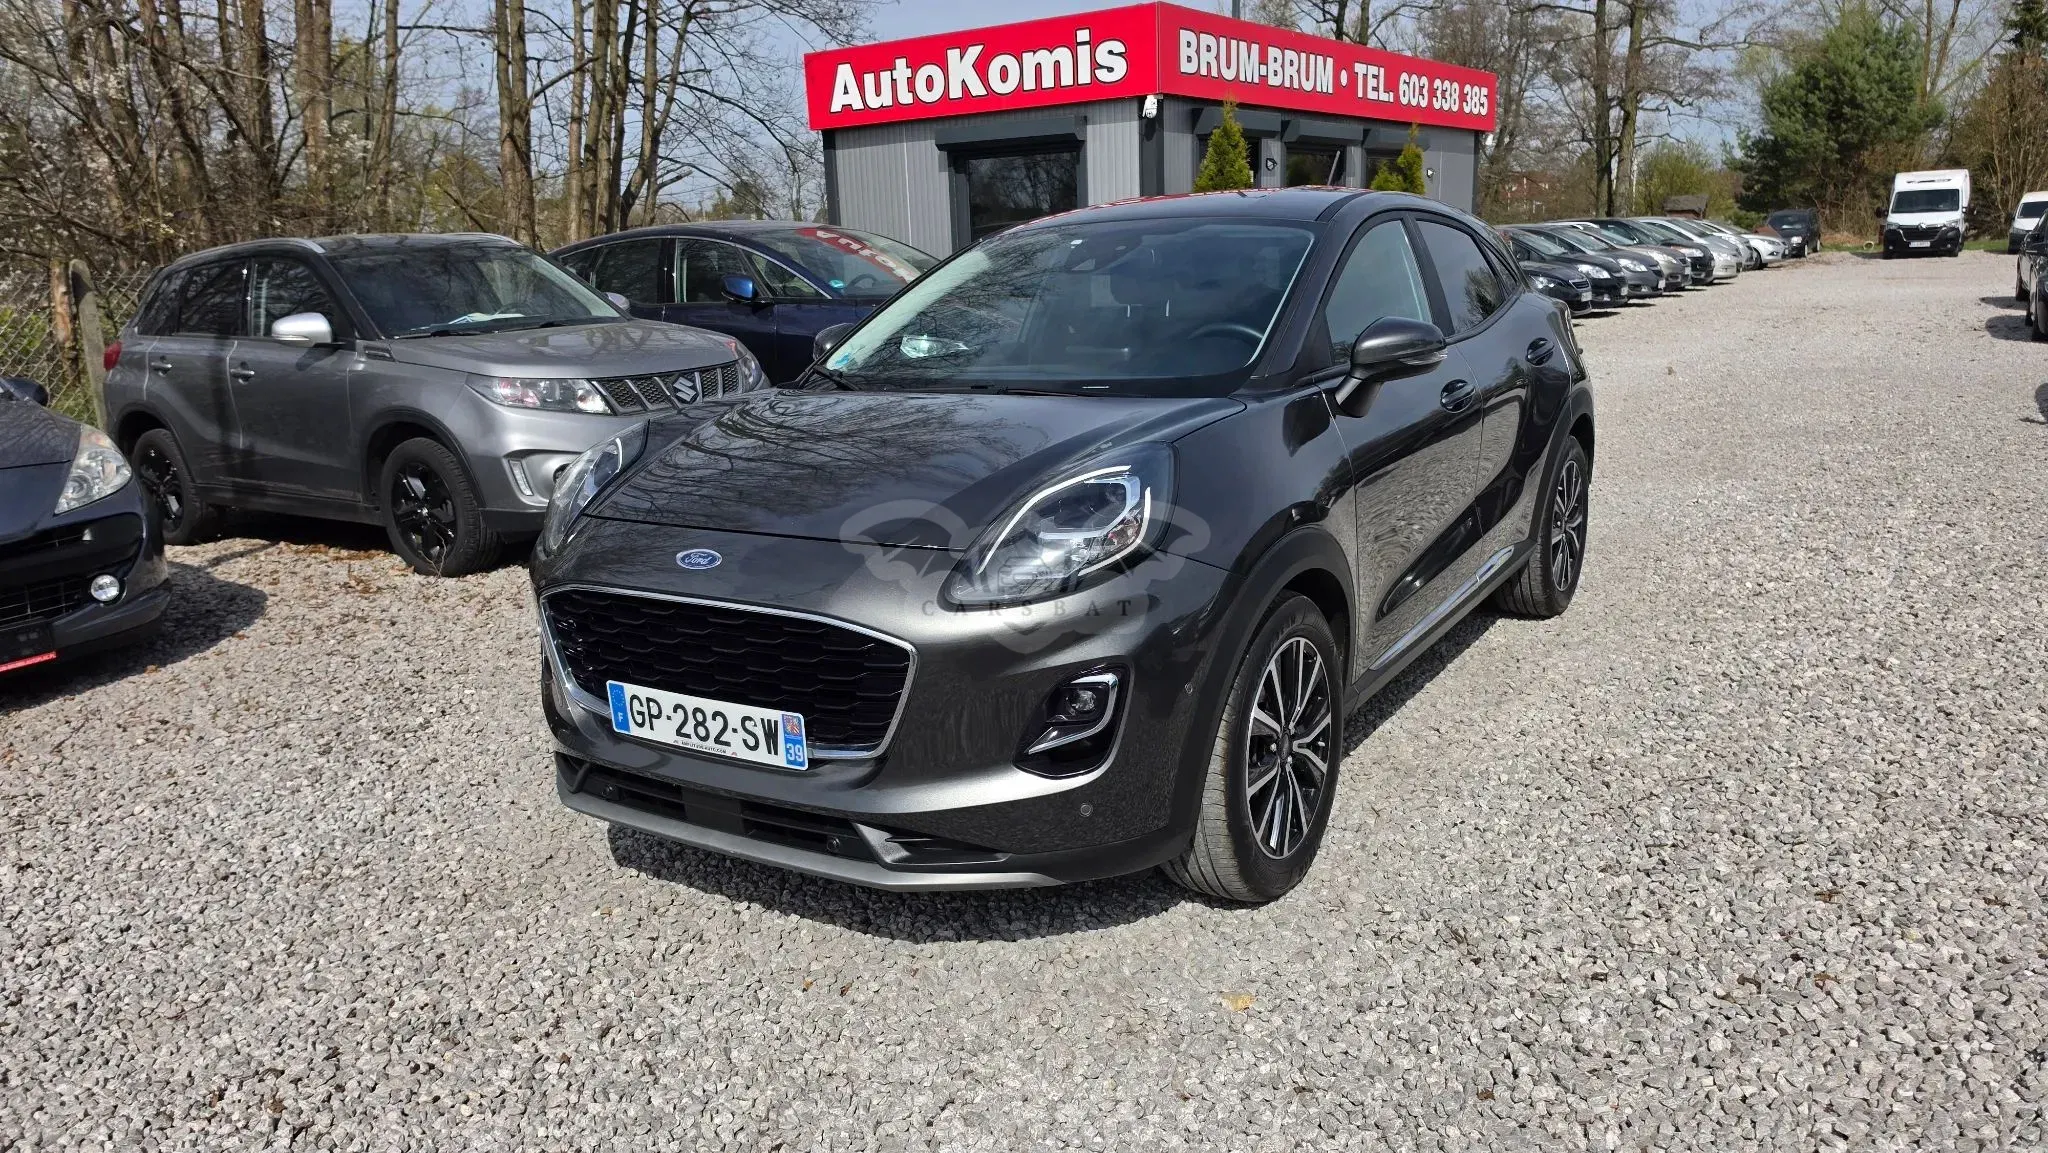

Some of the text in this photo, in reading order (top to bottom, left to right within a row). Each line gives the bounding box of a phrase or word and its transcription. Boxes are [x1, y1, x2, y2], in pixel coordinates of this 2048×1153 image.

[829, 27, 1128, 114] AutoKomis
[1179, 28, 1488, 116] BRUM-BRUM TEL. 603 338 385
[685, 552, 713, 565] Ford
[617, 712, 624, 722] F
[629, 694, 779, 756] GP-282-SW
[786, 742, 804, 762] 39
